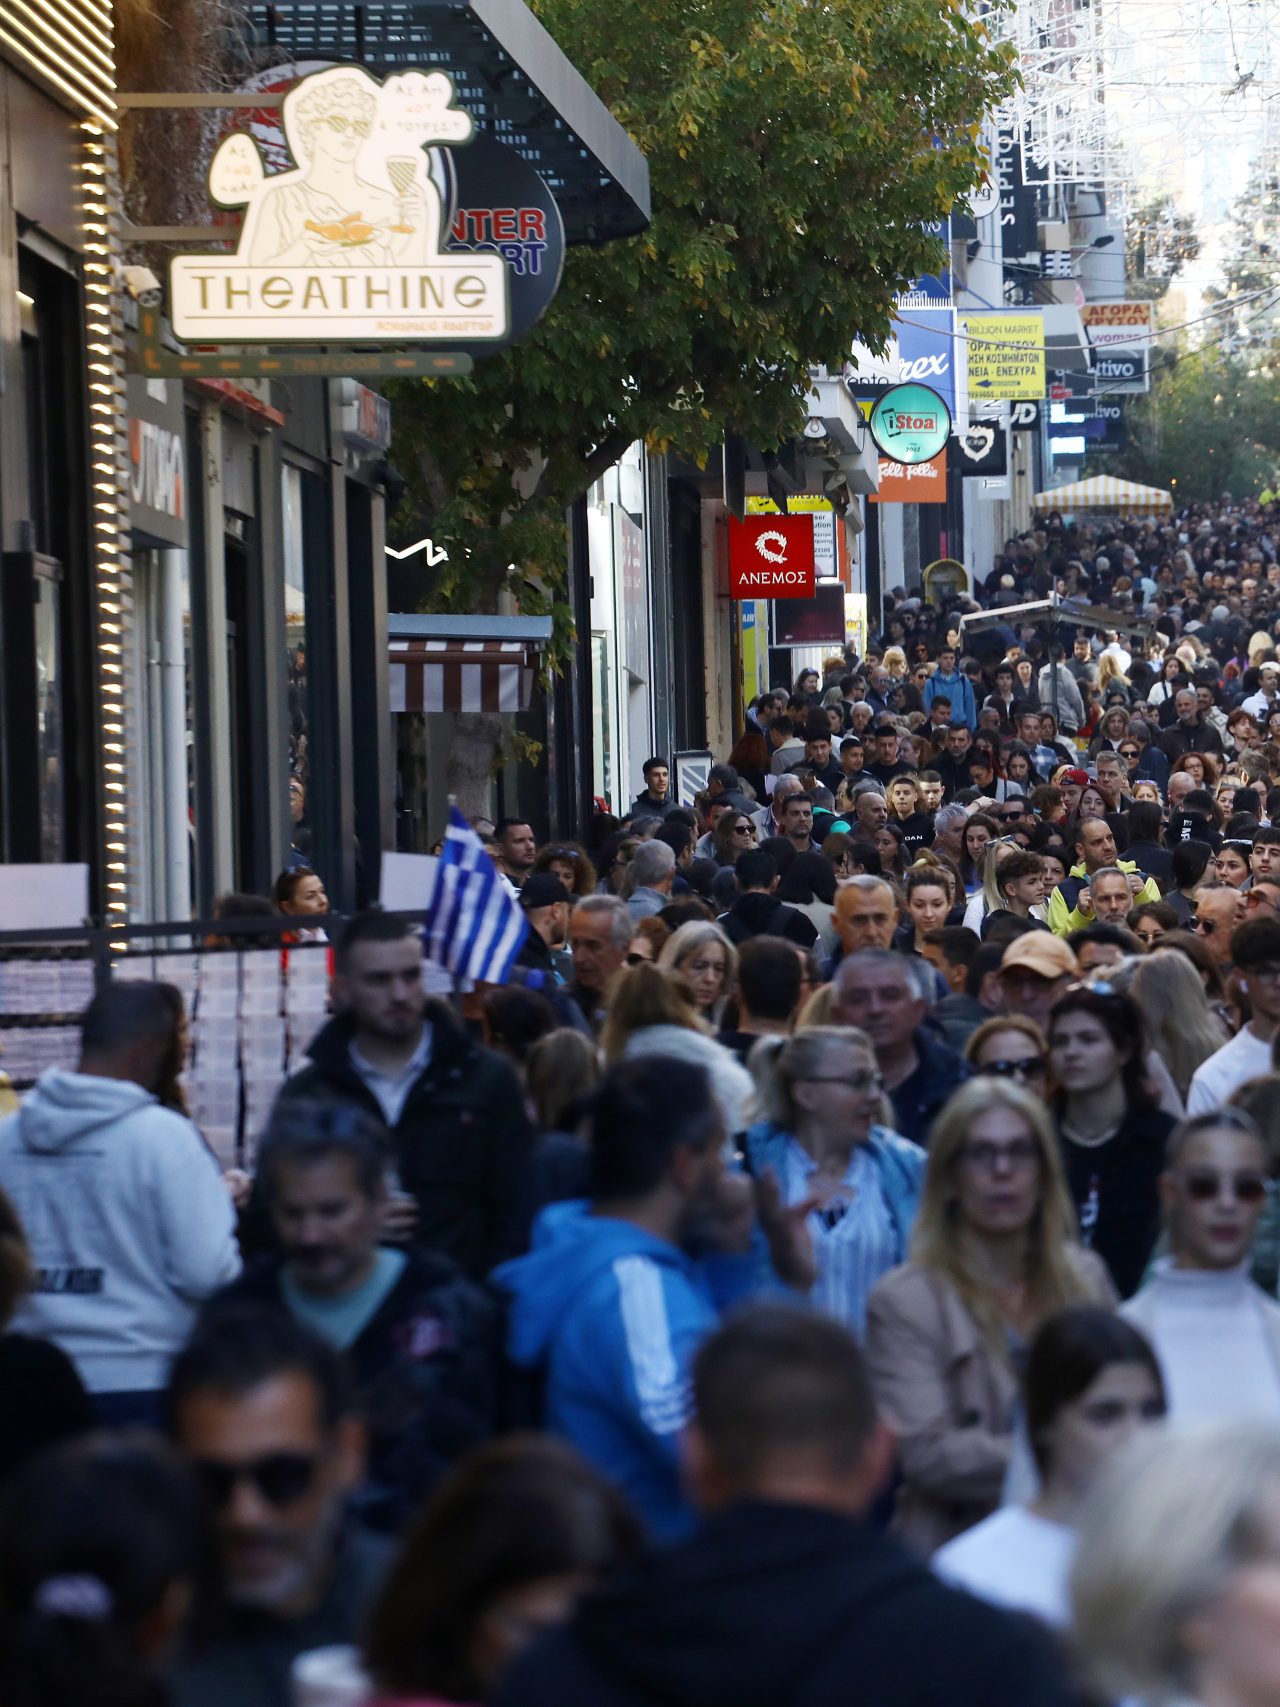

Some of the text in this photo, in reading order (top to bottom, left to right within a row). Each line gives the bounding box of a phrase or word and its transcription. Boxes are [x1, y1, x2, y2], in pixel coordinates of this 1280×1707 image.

[450, 208, 545, 242] NTER
[1089, 304, 1143, 316] ΑΓΟΡΑ
[1004, 325, 1039, 334] MARKET
[968, 354, 984, 364] ΗΣΗ
[968, 366, 989, 377] ΝΕΙΑ
[889, 415, 934, 429] iStoa
[907, 462, 938, 480] Follie
[739, 571, 807, 584] ΑΝΕΜΟΣ
